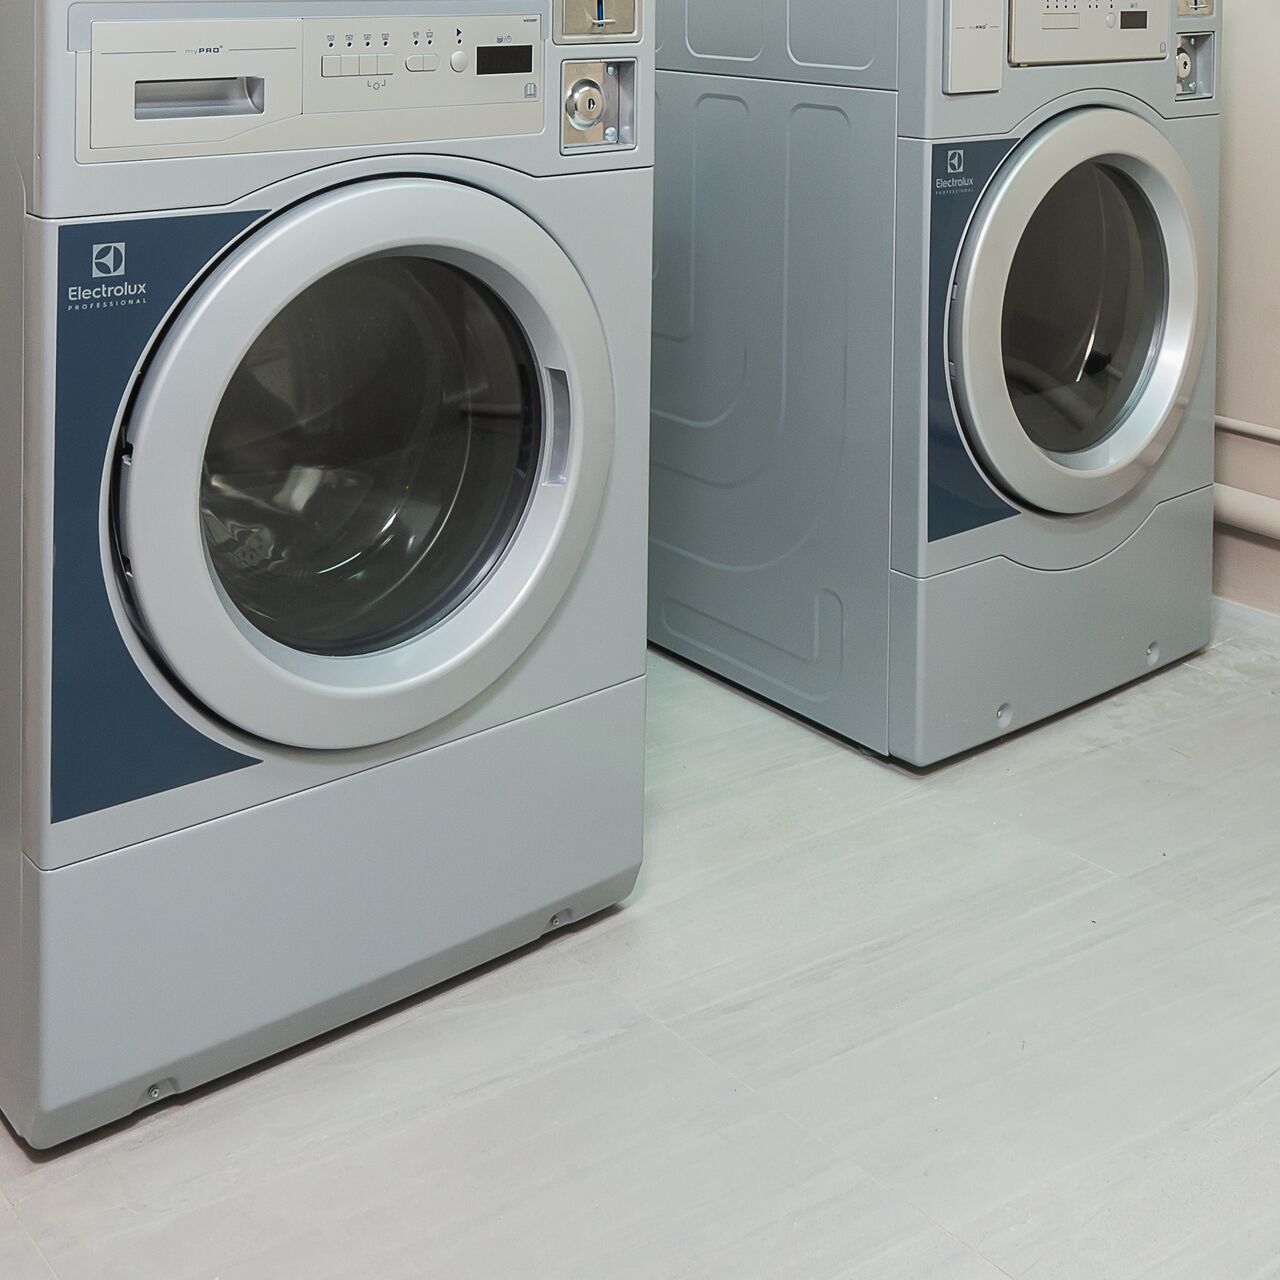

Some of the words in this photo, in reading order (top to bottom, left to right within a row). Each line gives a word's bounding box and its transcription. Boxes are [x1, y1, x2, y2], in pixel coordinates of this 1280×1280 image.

[936, 177, 974, 188] Electrolux
[68, 282, 147, 301] Electrolux
[67, 297, 147, 312] PROFESSIONAL
